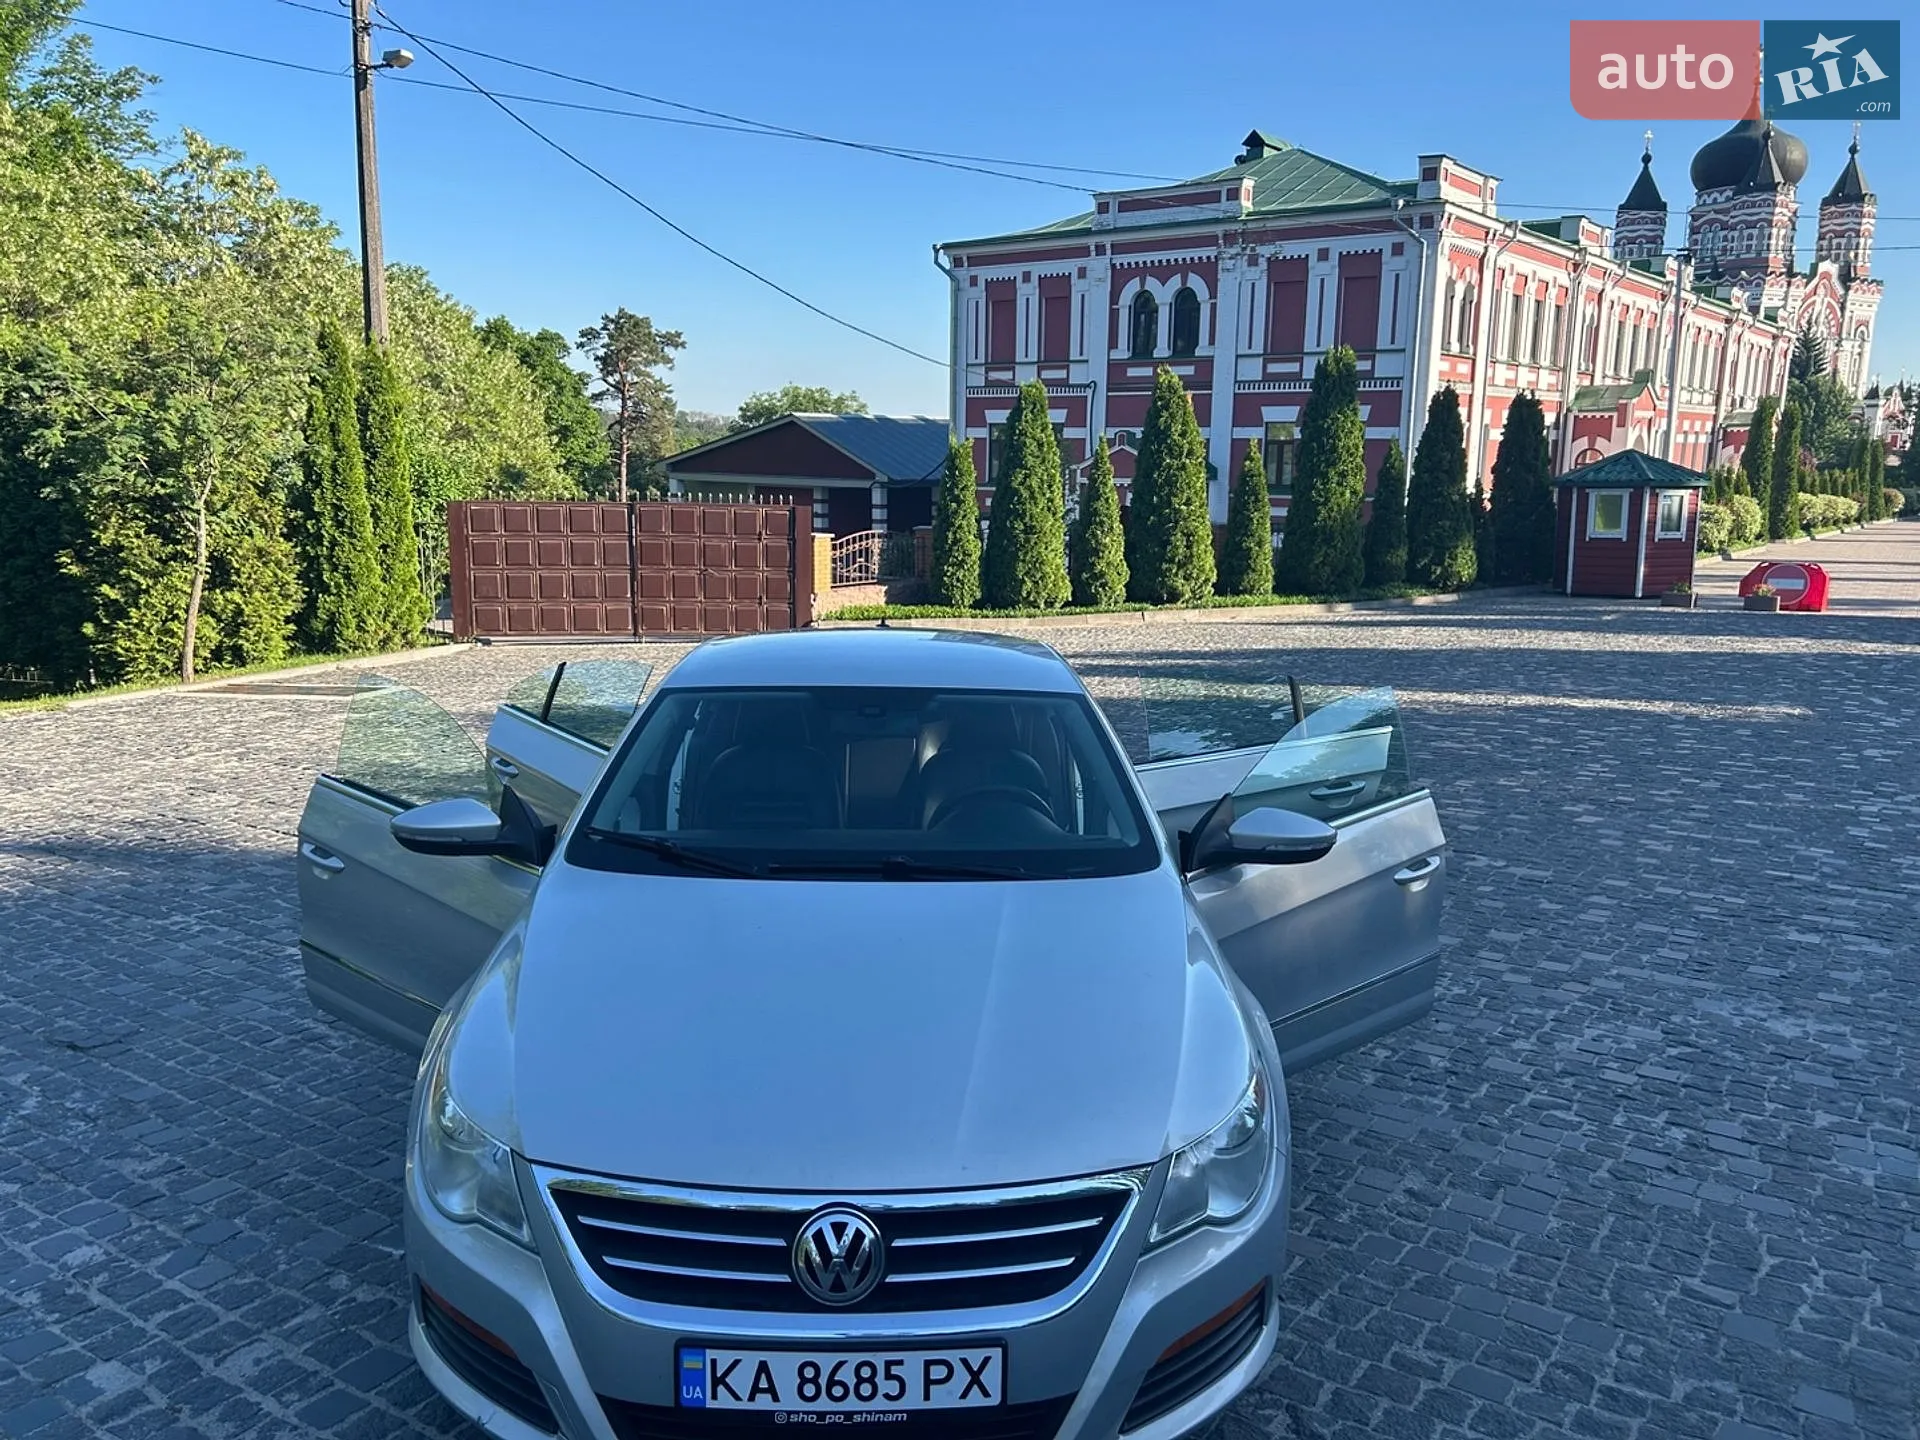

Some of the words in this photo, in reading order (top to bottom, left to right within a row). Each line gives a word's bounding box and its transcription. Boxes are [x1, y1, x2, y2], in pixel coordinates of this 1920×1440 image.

[682, 1385, 704, 1399] UA
[709, 1357, 781, 1403] KA
[796, 1358, 907, 1403] 8685
[921, 1355, 993, 1402] PX
